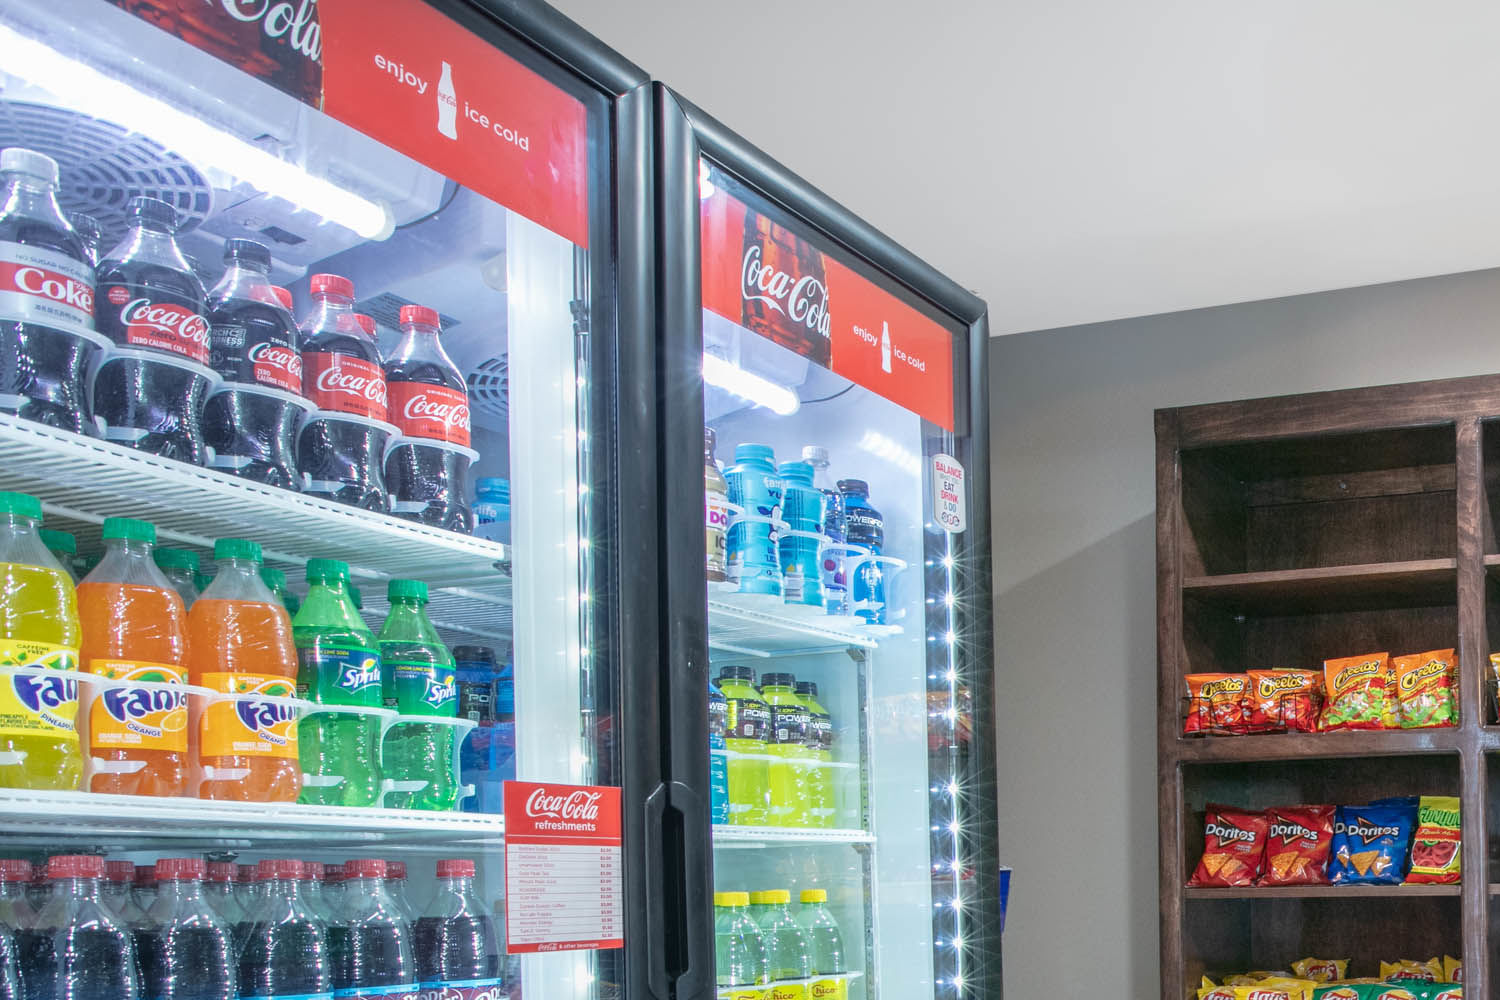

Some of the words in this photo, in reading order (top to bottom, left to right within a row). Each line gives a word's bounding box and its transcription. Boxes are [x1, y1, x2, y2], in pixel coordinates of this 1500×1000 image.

[374, 54, 427, 94] enjoy
[464, 102, 489, 127] ice
[493, 123, 529, 151] cold
[14, 266, 92, 313] Coke
[742, 245, 831, 339] Coca-Cola
[853, 325, 878, 346] enjoy
[894, 348, 907, 361] ice
[907, 353, 926, 371] cold
[935, 461, 963, 480] BALANCE
[943, 481, 955, 492] EAT
[940, 490, 959, 504] DRINK
[1334, 660, 1380, 690] Cheetos
[1401, 662, 1448, 691] Cheetos
[1202, 678, 1244, 700] Cheetos
[1259, 673, 1305, 698] Cheetos
[127, 723, 162, 738] ORANGE
[525, 788, 603, 820] Coca-Cola
[535, 820, 597, 832] refreshments
[1206, 823, 1256, 842] Doritos
[1271, 824, 1318, 841] Doritos
[1348, 825, 1399, 836] Doritos
[812, 984, 838, 998] Chico
